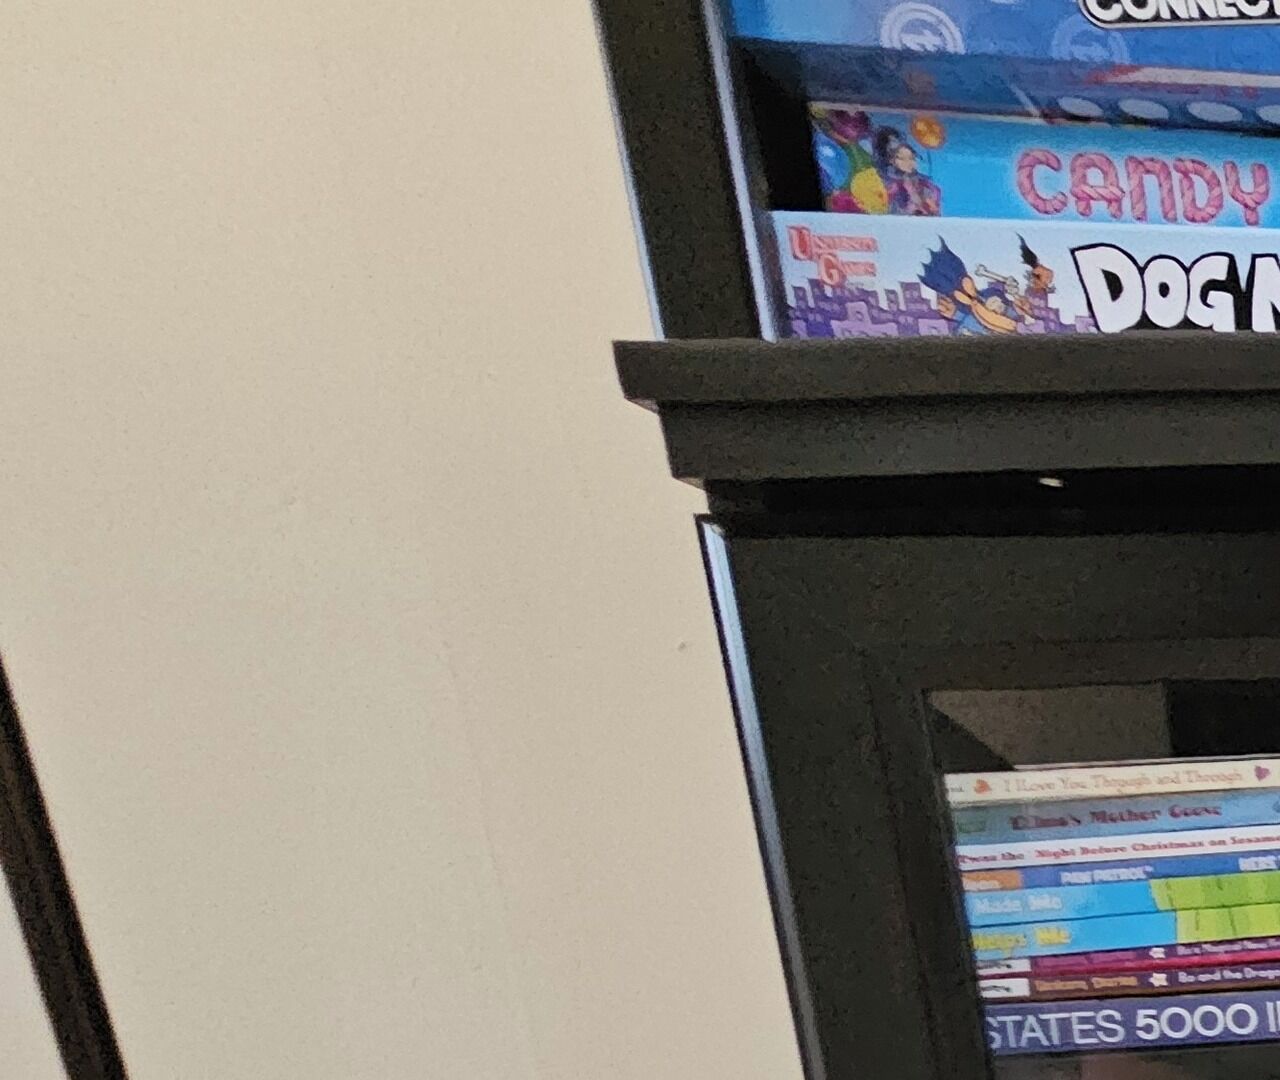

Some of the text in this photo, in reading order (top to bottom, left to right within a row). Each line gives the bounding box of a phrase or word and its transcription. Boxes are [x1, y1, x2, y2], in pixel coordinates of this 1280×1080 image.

[1016, 148, 1270, 226] CANDY
[1070, 243, 1238, 333] DOG
[1015, 778, 1056, 793] Love
[1059, 777, 1088, 791] You
[1156, 772, 1181, 785] and
[1001, 851, 1025, 862] the
[1034, 848, 1077, 860] Night
[1080, 845, 1128, 856] Before
[1131, 838, 1205, 852] Christmas
[1208, 838, 1227, 847] on
[986, 1008, 1126, 1050] STATES
[1135, 1004, 1259, 1041] 5000
